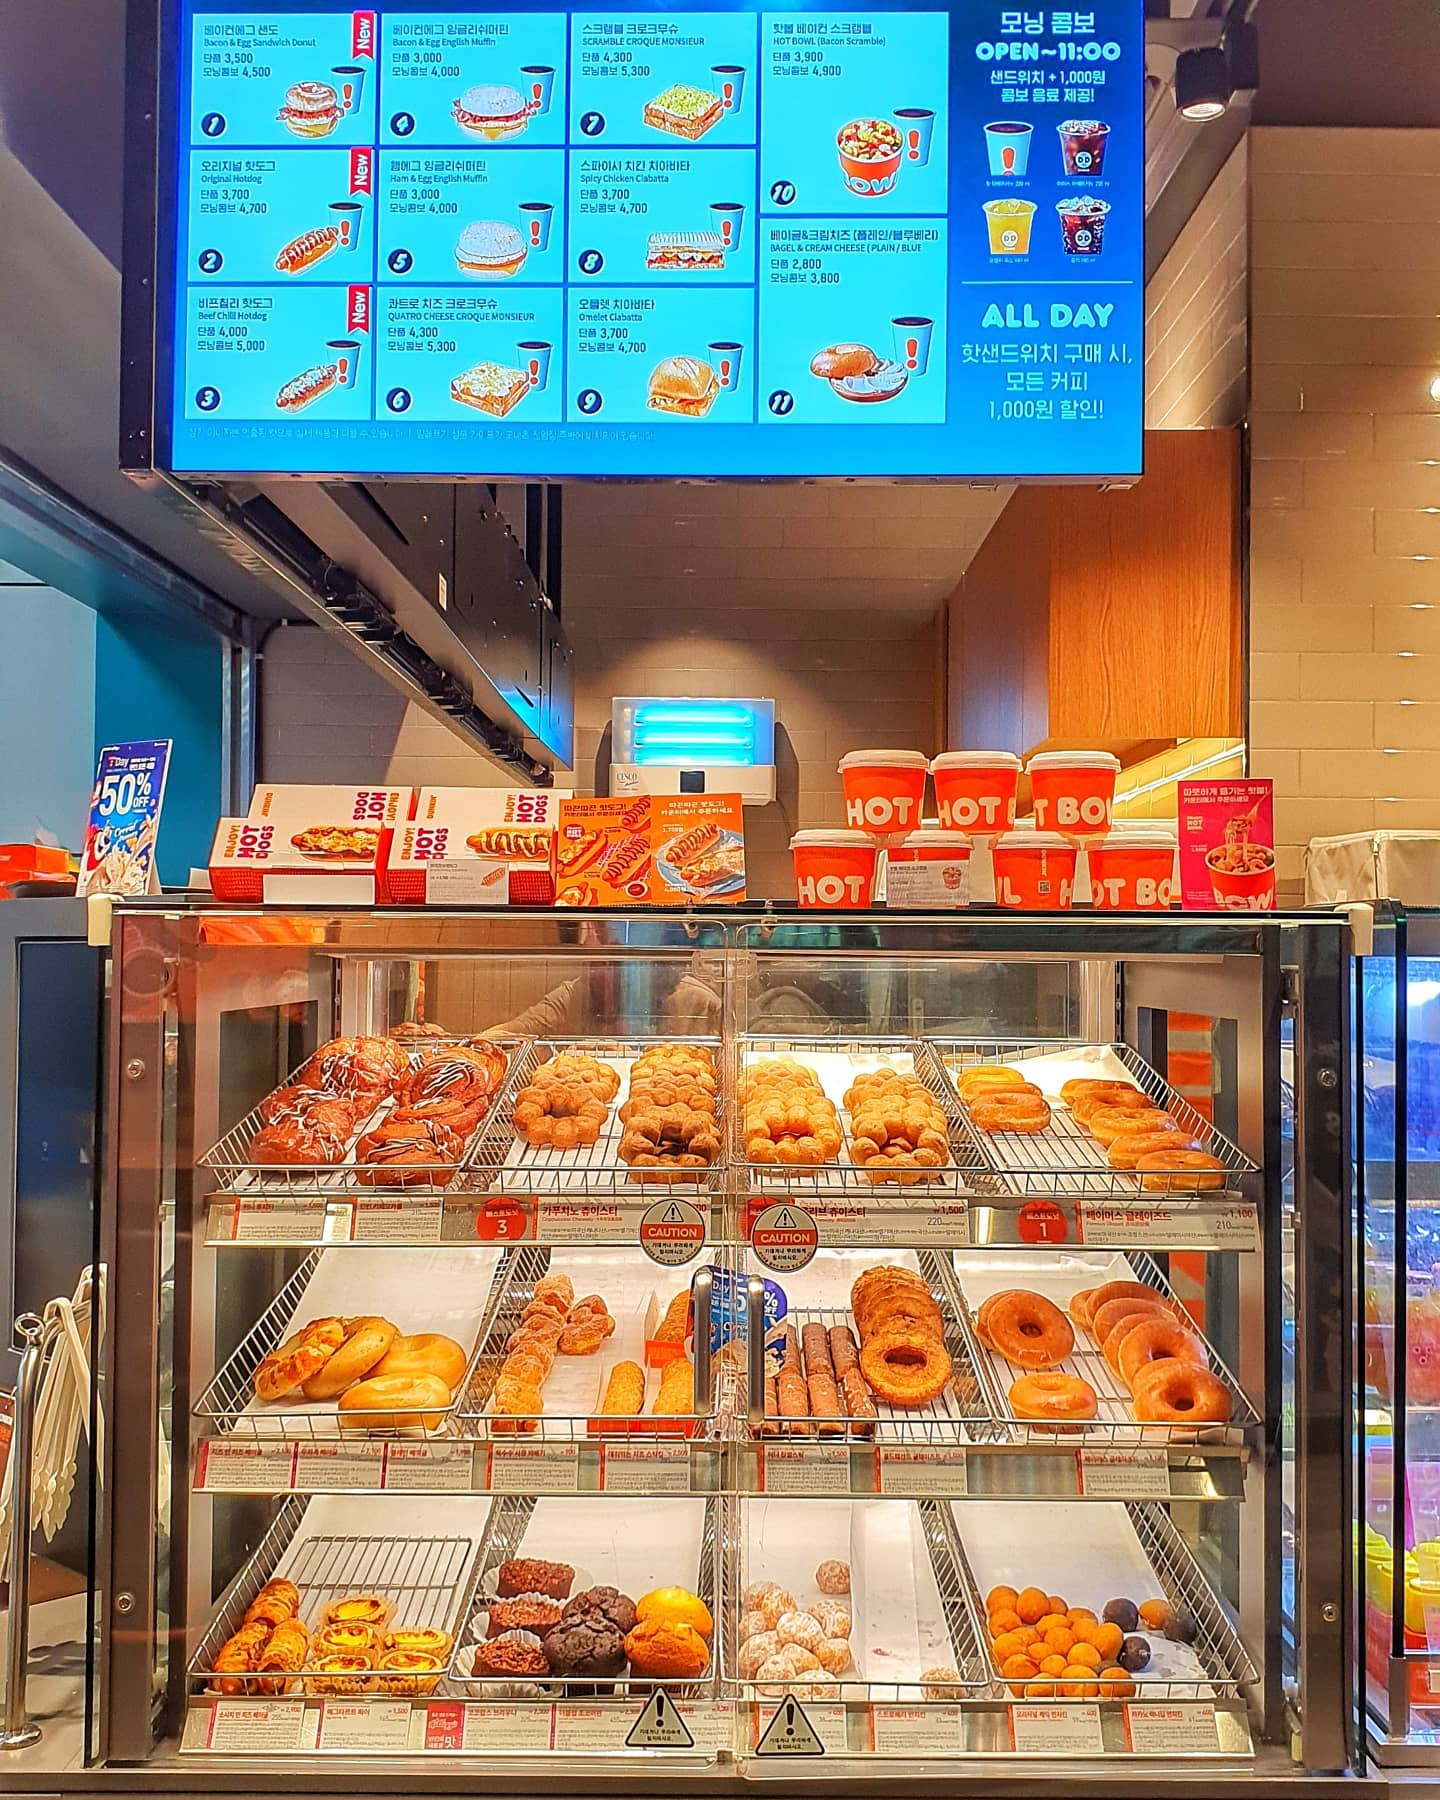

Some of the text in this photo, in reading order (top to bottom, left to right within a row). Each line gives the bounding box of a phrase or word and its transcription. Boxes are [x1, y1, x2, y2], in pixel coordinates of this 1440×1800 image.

[1001, 12, 1096, 34] 모닝 콤보
[258, 25, 278, 36] 샌도
[360, 18, 370, 49] New
[393, 25, 509, 35] 베이컨에그 잉글리쉬머핀
[626, 24, 679, 34] 크로크무슈
[797, 24, 827, 34] 베이컨
[204, 39, 316, 47] Bacon Egg Sandwich Donut
[393, 39, 495, 47] Bacon Egg English Muffin
[582, 38, 704, 46] SCRAMBLE CROQUE MONSIEUR
[774, 38, 886, 46] HOT BOWL (Bacon Scramble)
[204, 54, 253, 64] 단품 3,500
[393, 53, 442, 64] 단품 3,000
[582, 53, 632, 63] 단품 4,300
[773, 52, 823, 62] 단품 3,900
[204, 67, 271, 78] 모닝콤보 4,500
[392, 67, 460, 77] 모닝콤보 4,000
[582, 66, 650, 77] 모닝콤보 5,300
[773, 66, 841, 76] 모닝콤보 4,900
[991, 70, 1106, 85] 샌드위치 1,000원
[1002, 88, 1095, 102] 콤보 음료 제공!
[201, 161, 276, 172] 오리지널 핫도그
[355, 154, 368, 185] New
[391, 161, 486, 171] 햄에그 잉글리쉬머핀
[581, 161, 646, 171] 스파이시 치킨
[201, 175, 262, 184] Original Hotdog
[391, 175, 487, 184] Ham Egg English Muffin
[581, 175, 634, 183] Spicy Chicken
[201, 190, 249, 200] 단품 3,700
[390, 190, 440, 200] 단품 3,000
[581, 190, 629, 200] 단품 3,700
[200, 204, 267, 214] 모닝콤보 4,700
[390, 204, 458, 214] 모닝콤보 4,000
[580, 203, 647, 214] 모닝콤보 4,700
[771, 230, 850, 240] 베이글&크림치즈
[771, 244, 894, 252] BAGEL CREAM CHEESE PLAIN
[771, 259, 821, 270] 단품 2,800
[771, 273, 839, 284] 모닝콤보 3,800
[199, 298, 272, 309] 비프칠리 핫도그
[353, 292, 366, 324] New
[388, 299, 497, 309] 콰트로 치즈 크로크무슈
[613, 299, 654, 309] 치아바타
[199, 312, 267, 320] Beef Hotdog
[388, 313, 534, 321] QUATRO CHEESE CROQUE MONSIEUR
[579, 313, 608, 321] Omelet
[982, 304, 1114, 328] ALL DAY
[198, 327, 247, 338] 단품 4,000
[388, 328, 438, 338] 단품 4,300
[579, 328, 628, 339] 단품 3,700
[198, 341, 264, 352] 모닝콤보 5,000
[388, 342, 455, 352] 모닝콤보 5,300
[579, 343, 646, 353] 모닝콤보 4,700
[961, 344, 1133, 364] 핫샌드위치 구매 시,
[1006, 371, 1088, 391] 모든 커피
[989, 400, 1104, 420] 1,000원 할인!
[100, 772, 151, 816] 50%
[133, 797, 149, 808] OFF
[353, 792, 369, 820] DOGS
[366, 792, 387, 820] HOT
[386, 793, 400, 821] ENJOY!
[504, 794, 515, 823] ENJOY!
[516, 794, 535, 823] HOT
[532, 794, 548, 823] DOGS
[846, 797, 913, 827] HOT
[938, 797, 1001, 828] HOT
[224, 825, 239, 858] ENJOY!
[238, 825, 260, 858] HOT
[256, 825, 275, 859] DOGS
[400, 828, 416, 860] ENJOY!
[414, 828, 434, 860] HOT
[430, 828, 449, 860] DOGS
[798, 876, 865, 904] HOT
[1087, 1211, 1122, 1221] 페이머스
[1126, 1211, 1171, 1221] 글레이즈드
[497, 1220, 507, 1234] 3
[1039, 1223, 1047, 1237] 1
[648, 1228, 698, 1238] CAUTION
[760, 1234, 810, 1243] CAUTION
